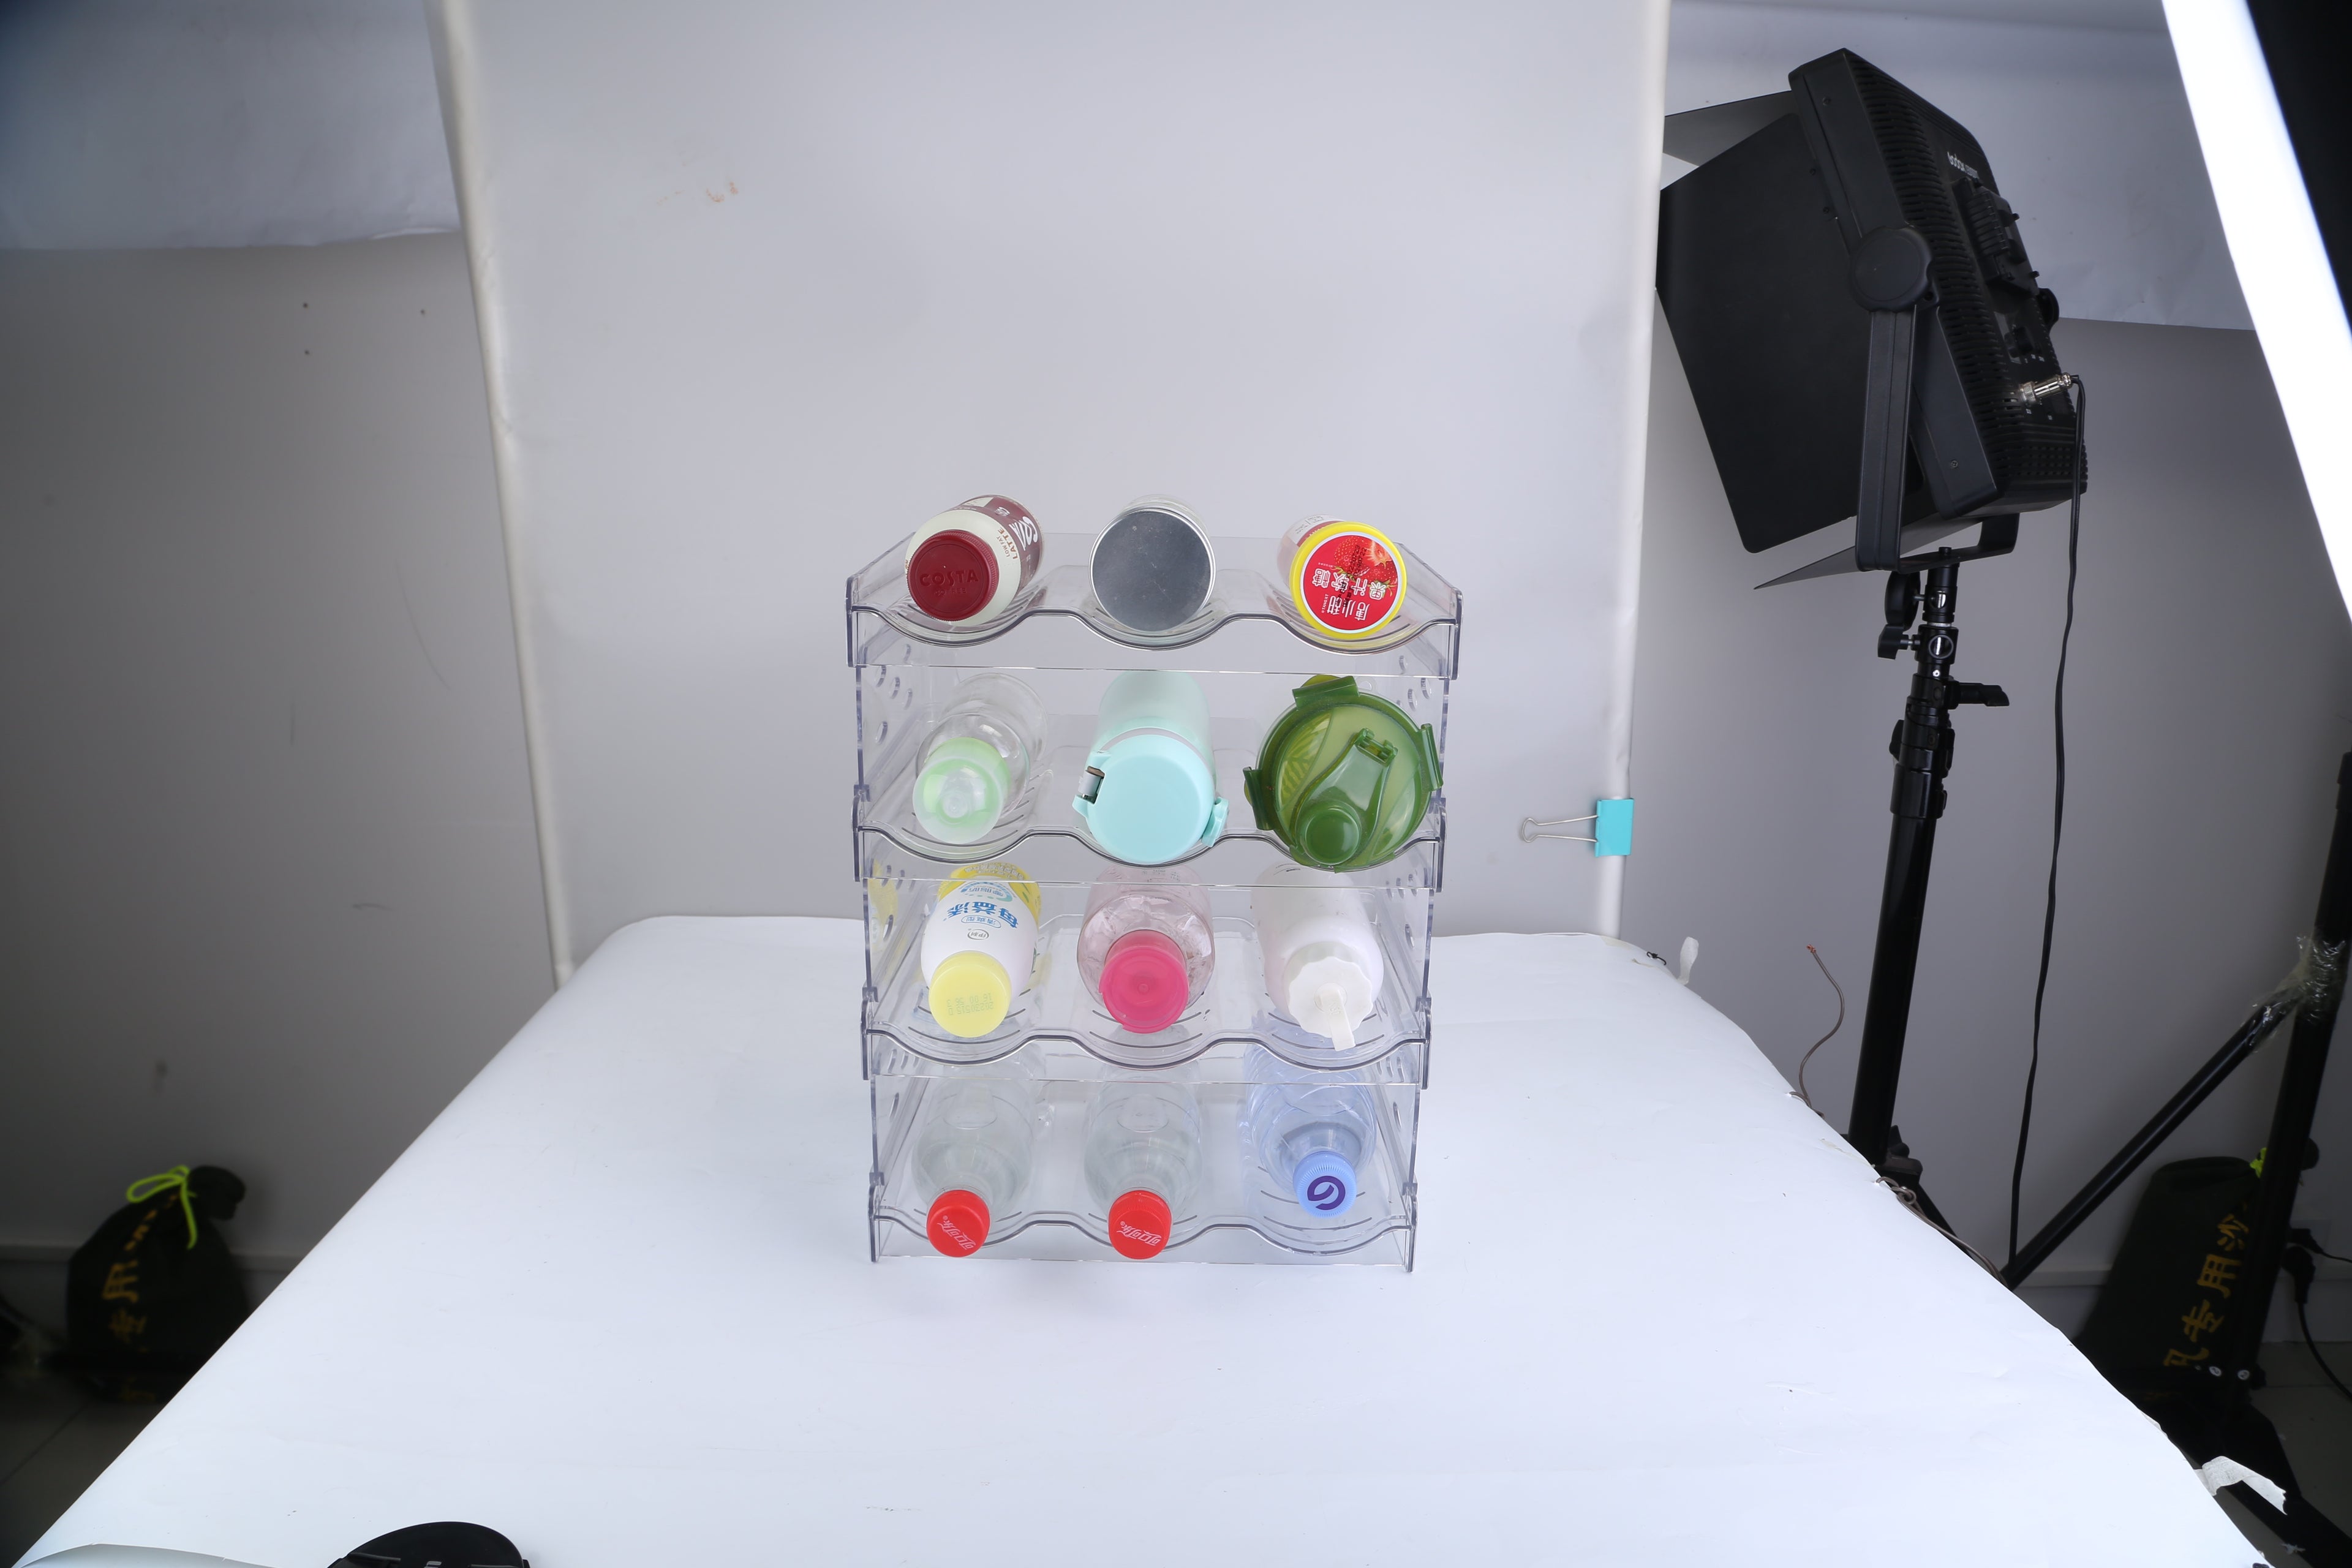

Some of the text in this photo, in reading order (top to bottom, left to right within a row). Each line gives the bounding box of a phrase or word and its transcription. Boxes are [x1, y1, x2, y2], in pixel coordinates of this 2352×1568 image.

[996, 535, 1005, 545] FAT
[998, 527, 1018, 559] LATTE
[919, 569, 979, 586] COSTA
[1312, 568, 1386, 600] 果汁软糖
[1327, 595, 1370, 621] 唐小甜
[947, 902, 1019, 929] 每益添
[937, 1219, 976, 1250] 可口可乐
[1116, 1224, 1162, 1246] 可口可乐
